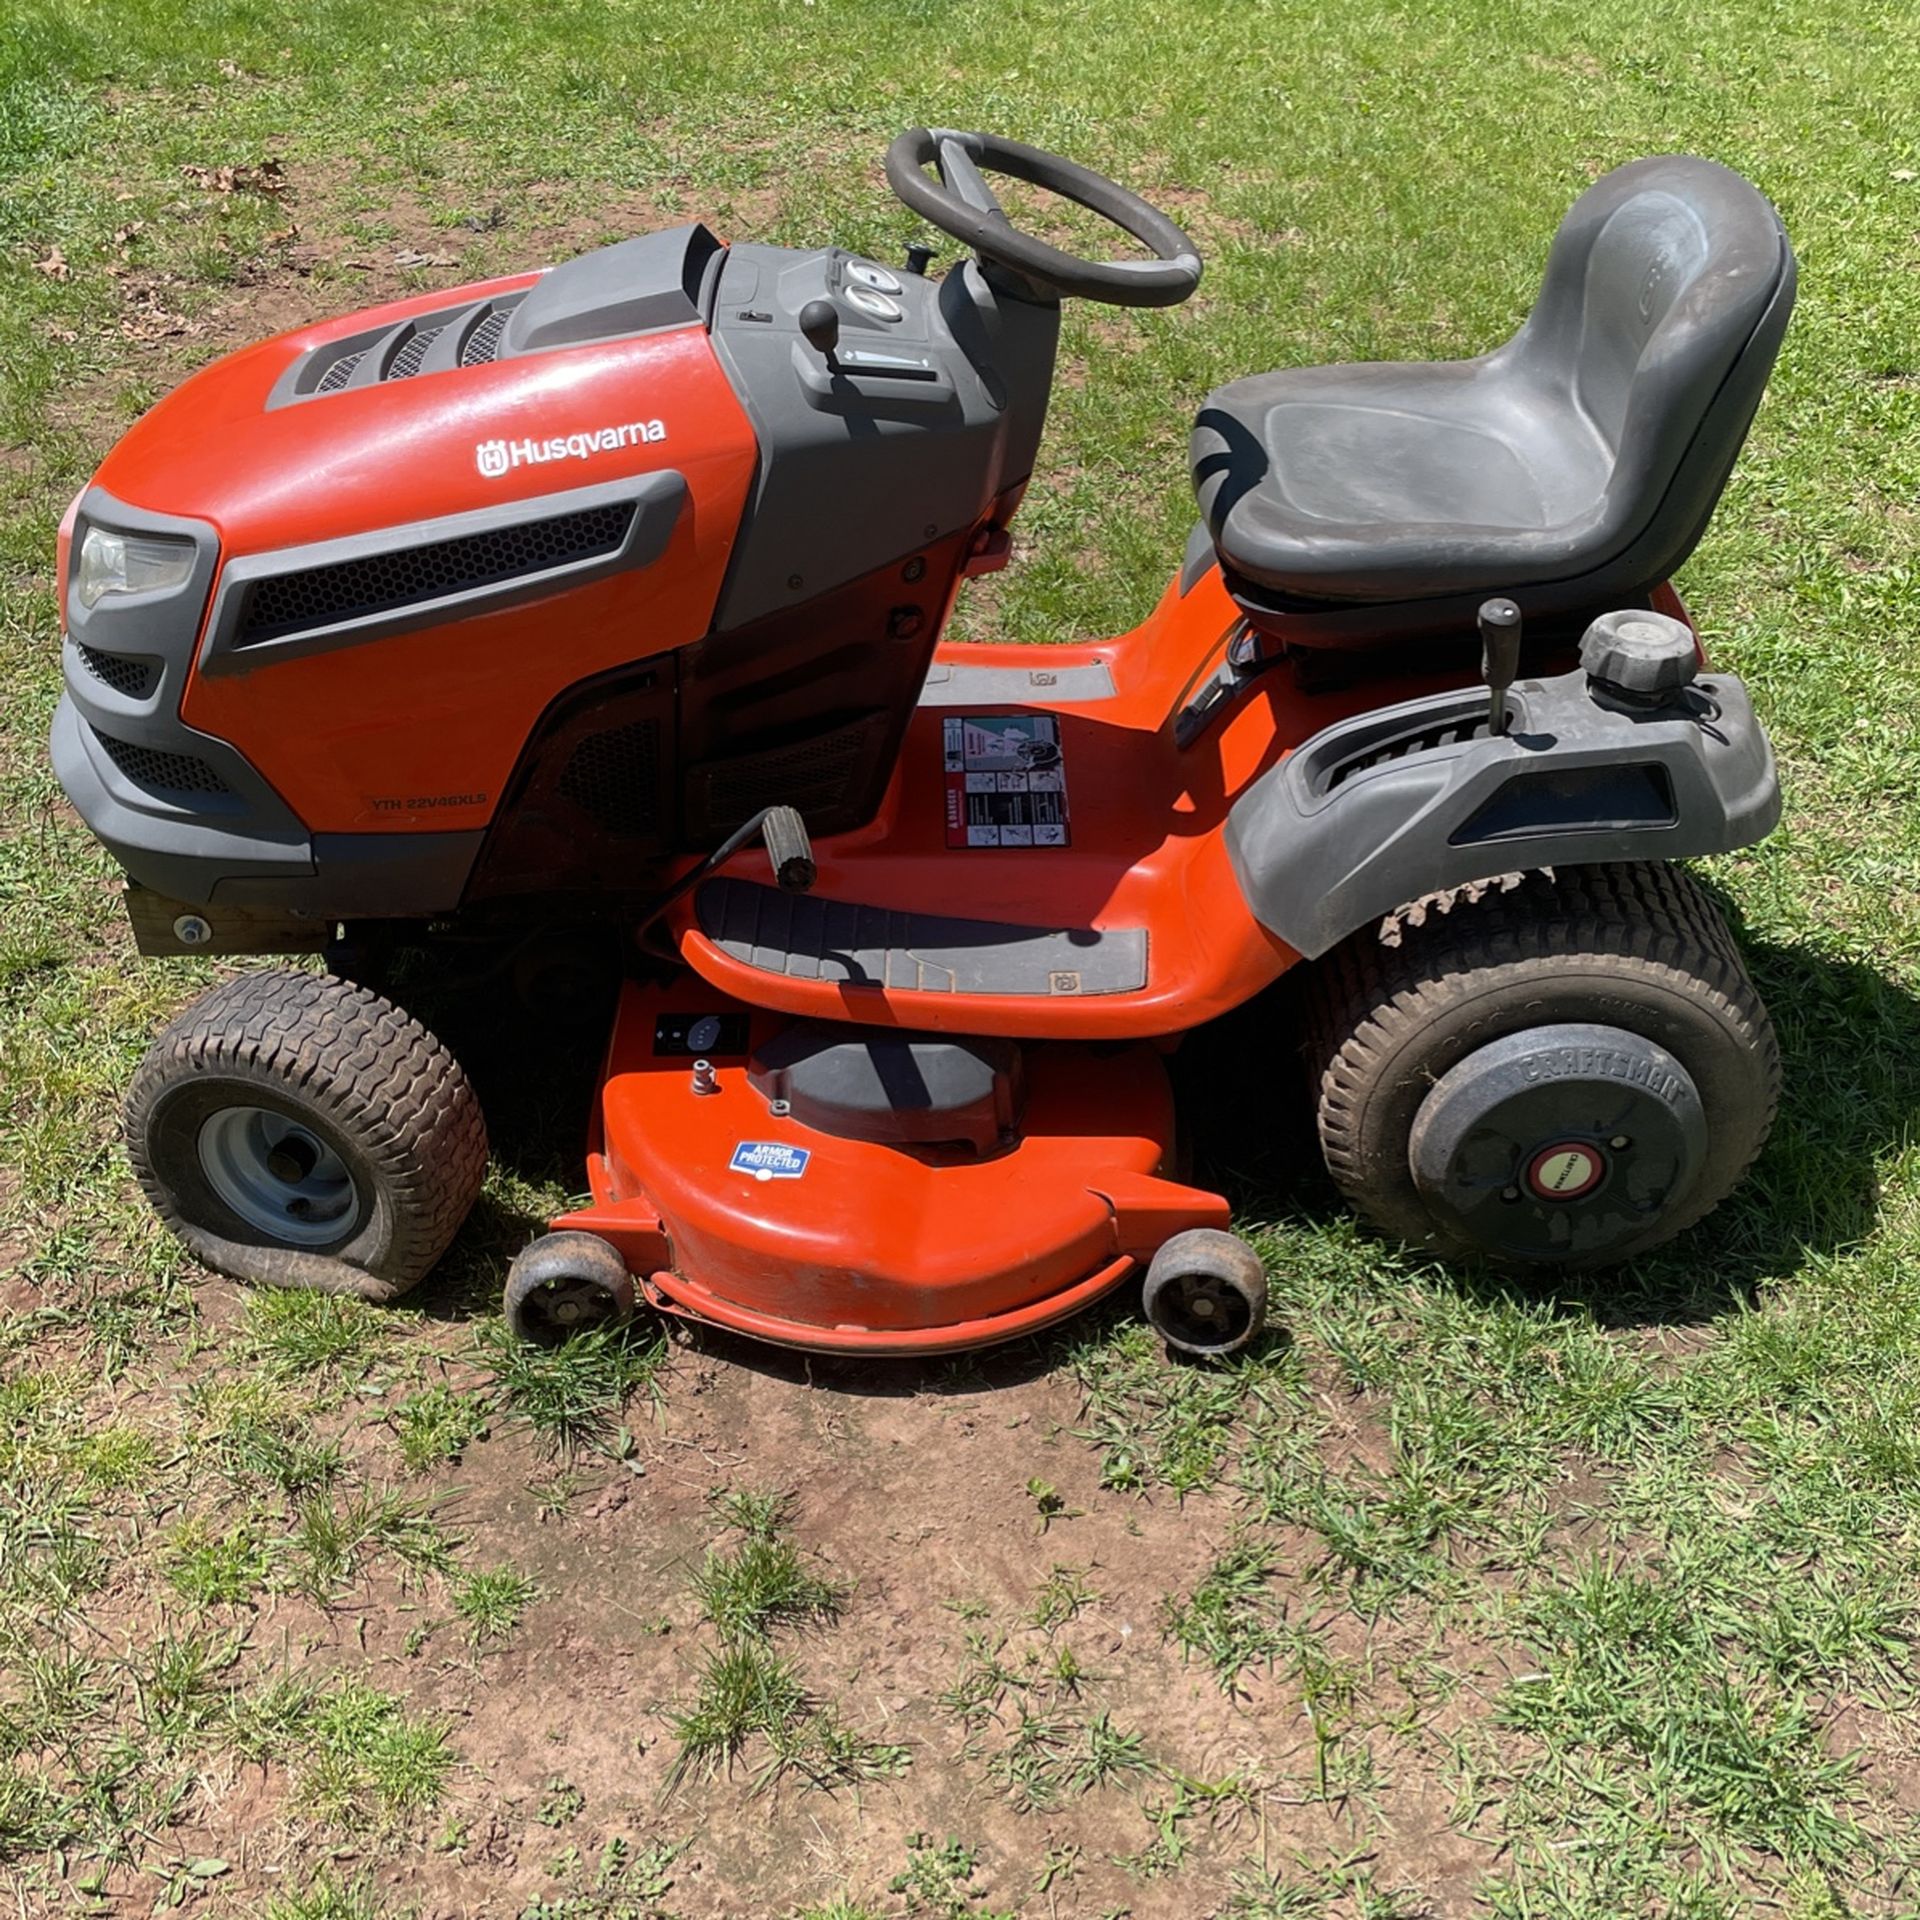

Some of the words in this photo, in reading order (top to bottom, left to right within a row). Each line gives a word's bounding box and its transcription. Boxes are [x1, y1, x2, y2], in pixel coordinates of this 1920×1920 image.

[511, 419, 666, 466] Husqvarna
[372, 799, 401, 810] YTH
[1521, 1049, 1681, 1103] CRAFTSMAN
[739, 1151, 802, 1168] PROTECTED
[753, 1145, 794, 1158] ARMOR
